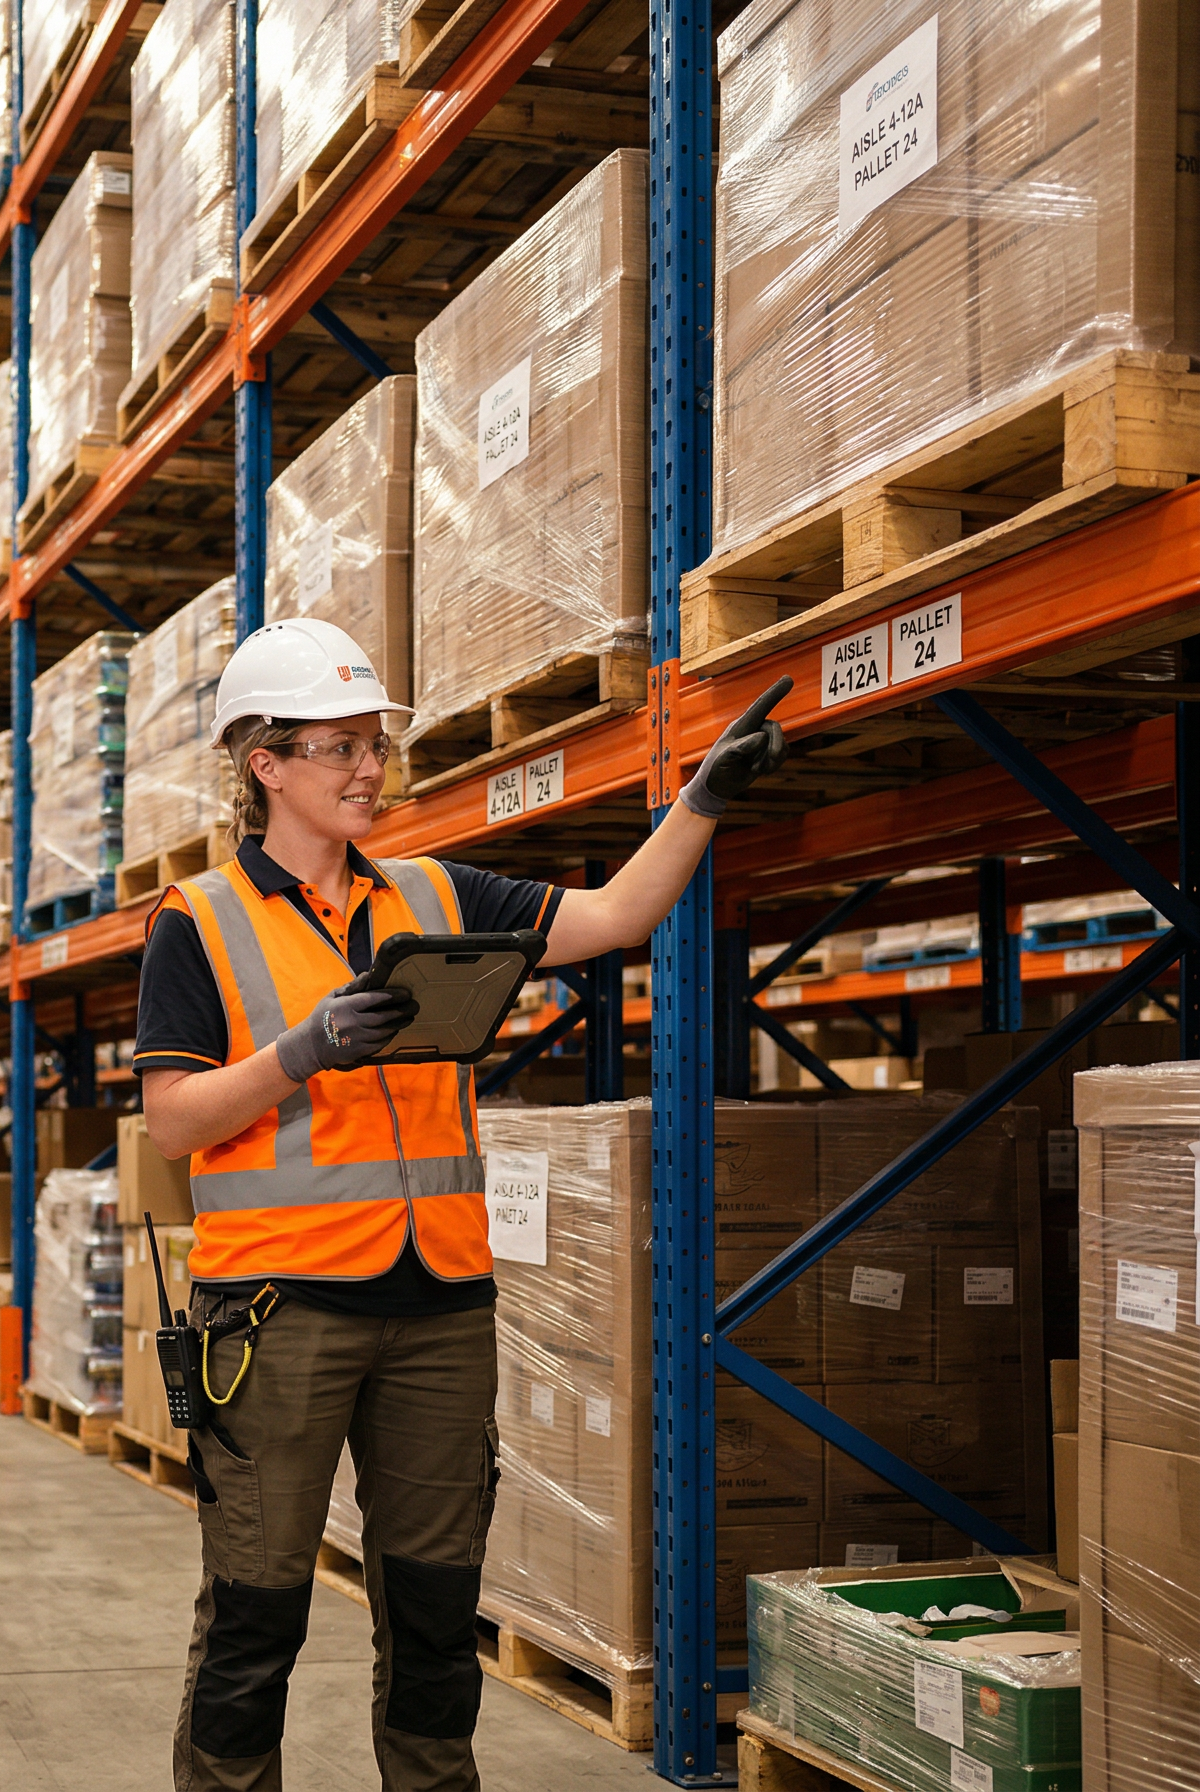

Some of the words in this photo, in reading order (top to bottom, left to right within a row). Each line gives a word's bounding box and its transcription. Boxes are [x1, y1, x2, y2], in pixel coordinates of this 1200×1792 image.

[851, 118, 886, 163] AISLE
[888, 92, 924, 131] 4-12A
[854, 140, 900, 191] PALLET
[903, 127, 918, 155] 24
[900, 604, 953, 641] PALLET
[834, 635, 872, 665] AISLE
[914, 636, 936, 669] 24
[828, 659, 880, 696] 4-12A
[494, 772, 517, 794] AISLE
[529, 756, 559, 780] PALLET
[490, 790, 521, 817] 4-12A
[536, 778, 551, 802] 24
